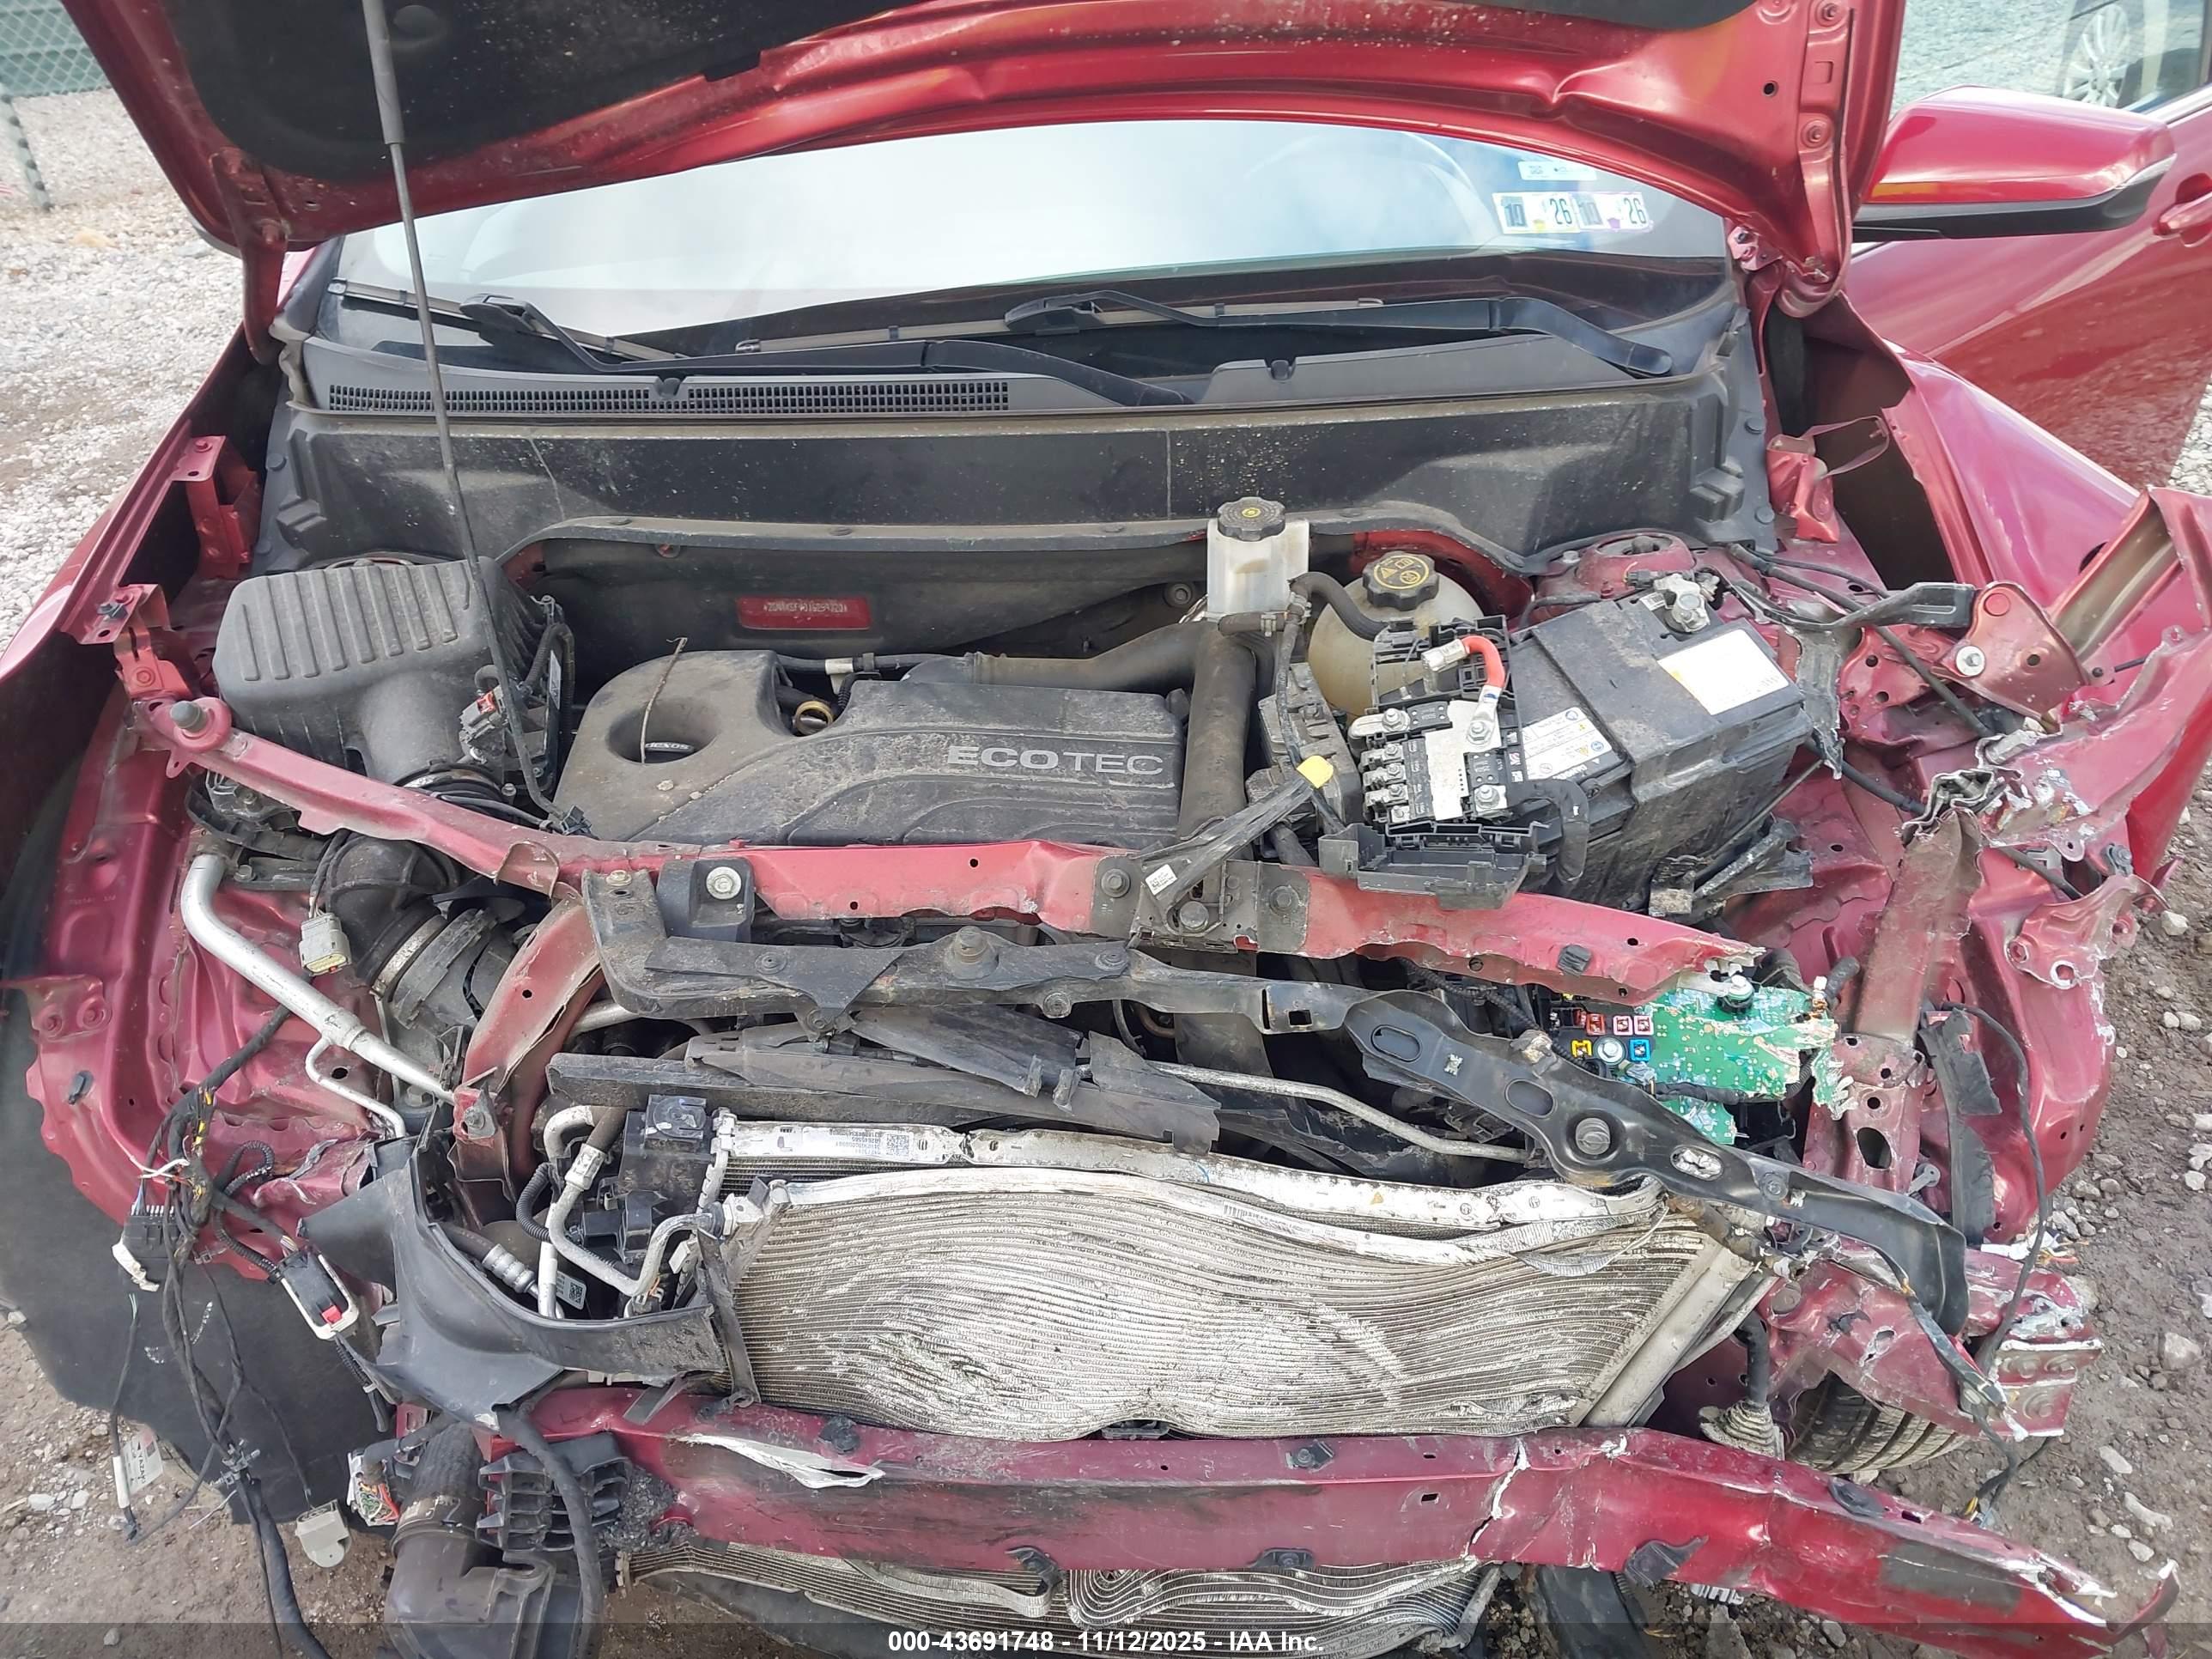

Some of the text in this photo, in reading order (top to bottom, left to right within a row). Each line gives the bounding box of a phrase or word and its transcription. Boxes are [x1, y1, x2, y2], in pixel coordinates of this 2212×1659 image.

[1549, 198, 1573, 225] 26
[1623, 198, 1647, 225] 26
[947, 745, 1164, 775] ECOTEC
